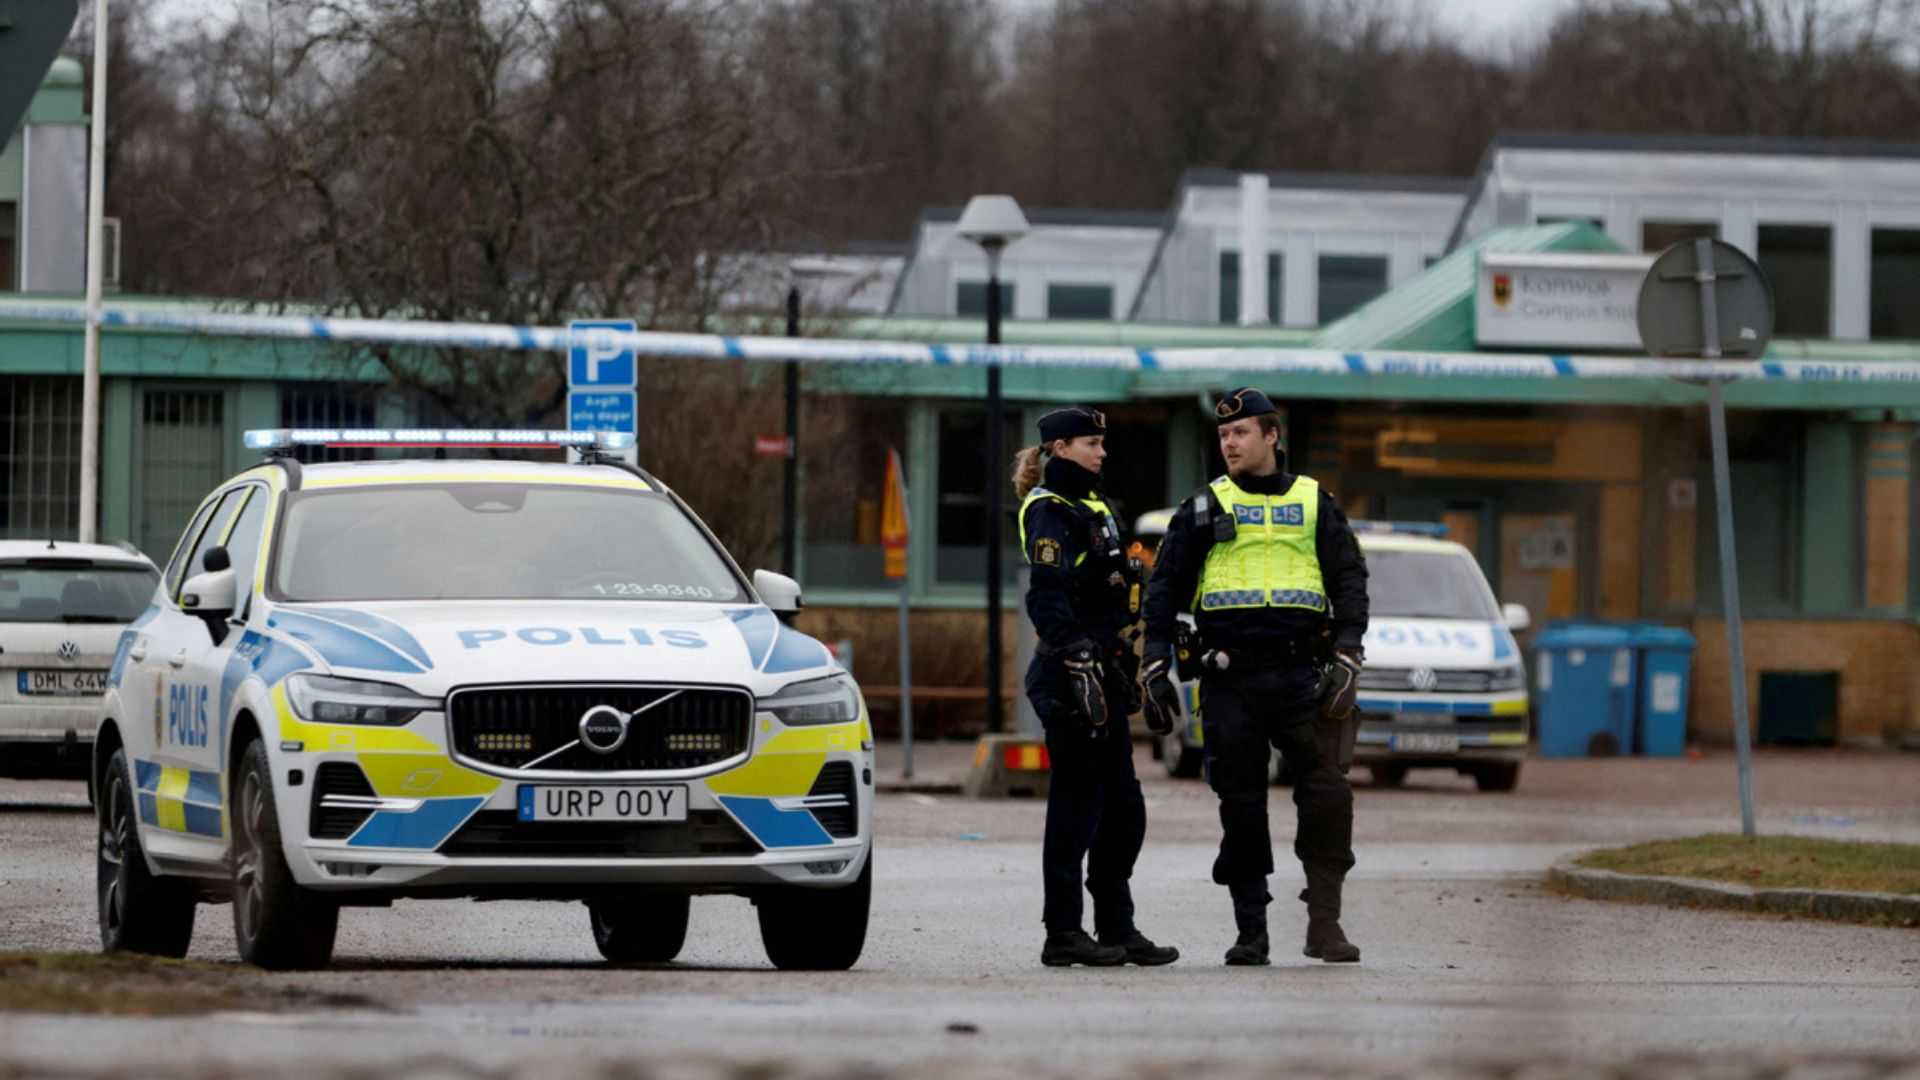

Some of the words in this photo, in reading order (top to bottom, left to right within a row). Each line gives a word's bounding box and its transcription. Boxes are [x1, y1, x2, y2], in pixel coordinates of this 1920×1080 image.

[586, 328, 623, 381] P
[1236, 506, 1301, 523] POLIS
[613, 583, 713, 598] 23-9340
[456, 627, 708, 649] POLIS
[34, 673, 67, 689] DML
[169, 683, 208, 748] POLIS
[547, 789, 604, 816] URP
